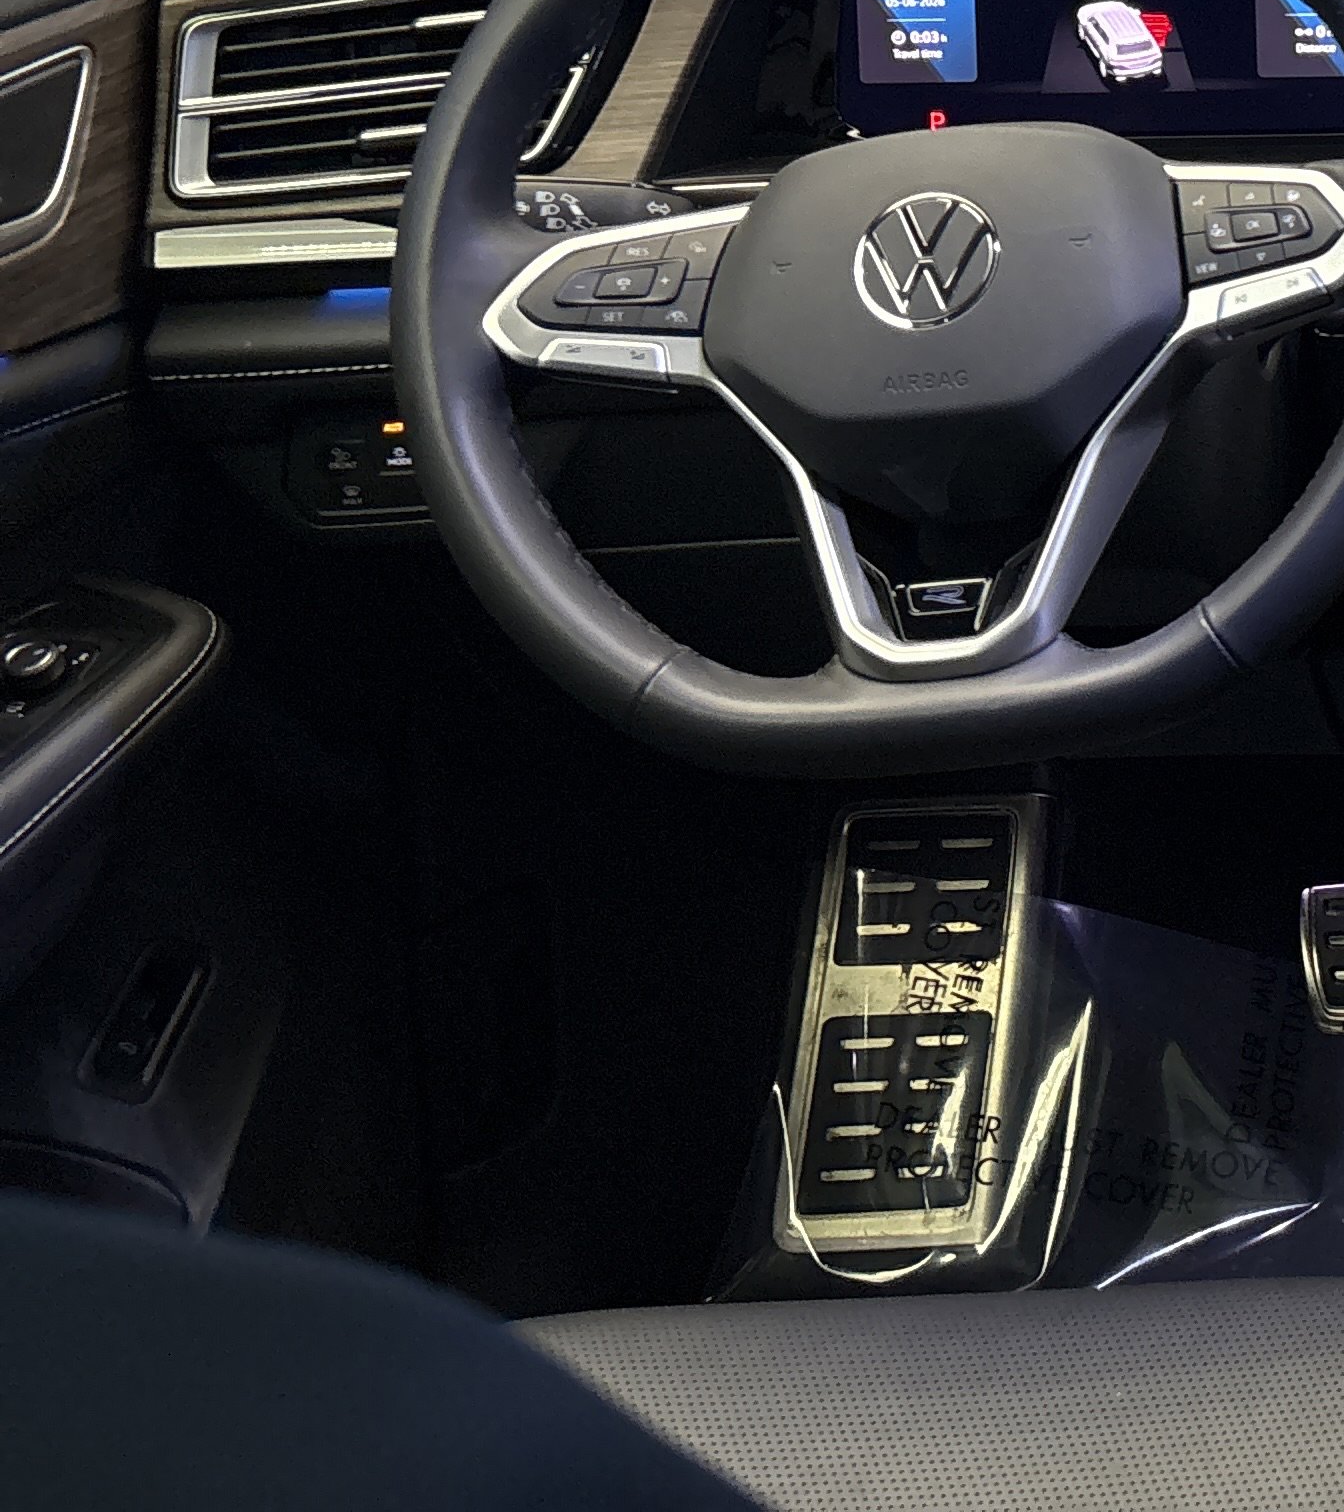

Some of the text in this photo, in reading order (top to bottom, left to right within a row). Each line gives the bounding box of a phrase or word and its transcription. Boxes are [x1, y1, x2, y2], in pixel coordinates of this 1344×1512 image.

[909, 30, 940, 44] 0:03
[892, 49, 943, 59] Travel time
[928, 111, 947, 132] P
[625, 246, 650, 257] RES
[602, 311, 626, 323] SET
[882, 369, 971, 395] AIRBAG
[895, 900, 959, 1014] COVER
[1226, 1031, 1268, 1144] DEALER
[1141, 1137, 1282, 1186] REMOVE
[1084, 1172, 1196, 1214] COVER
